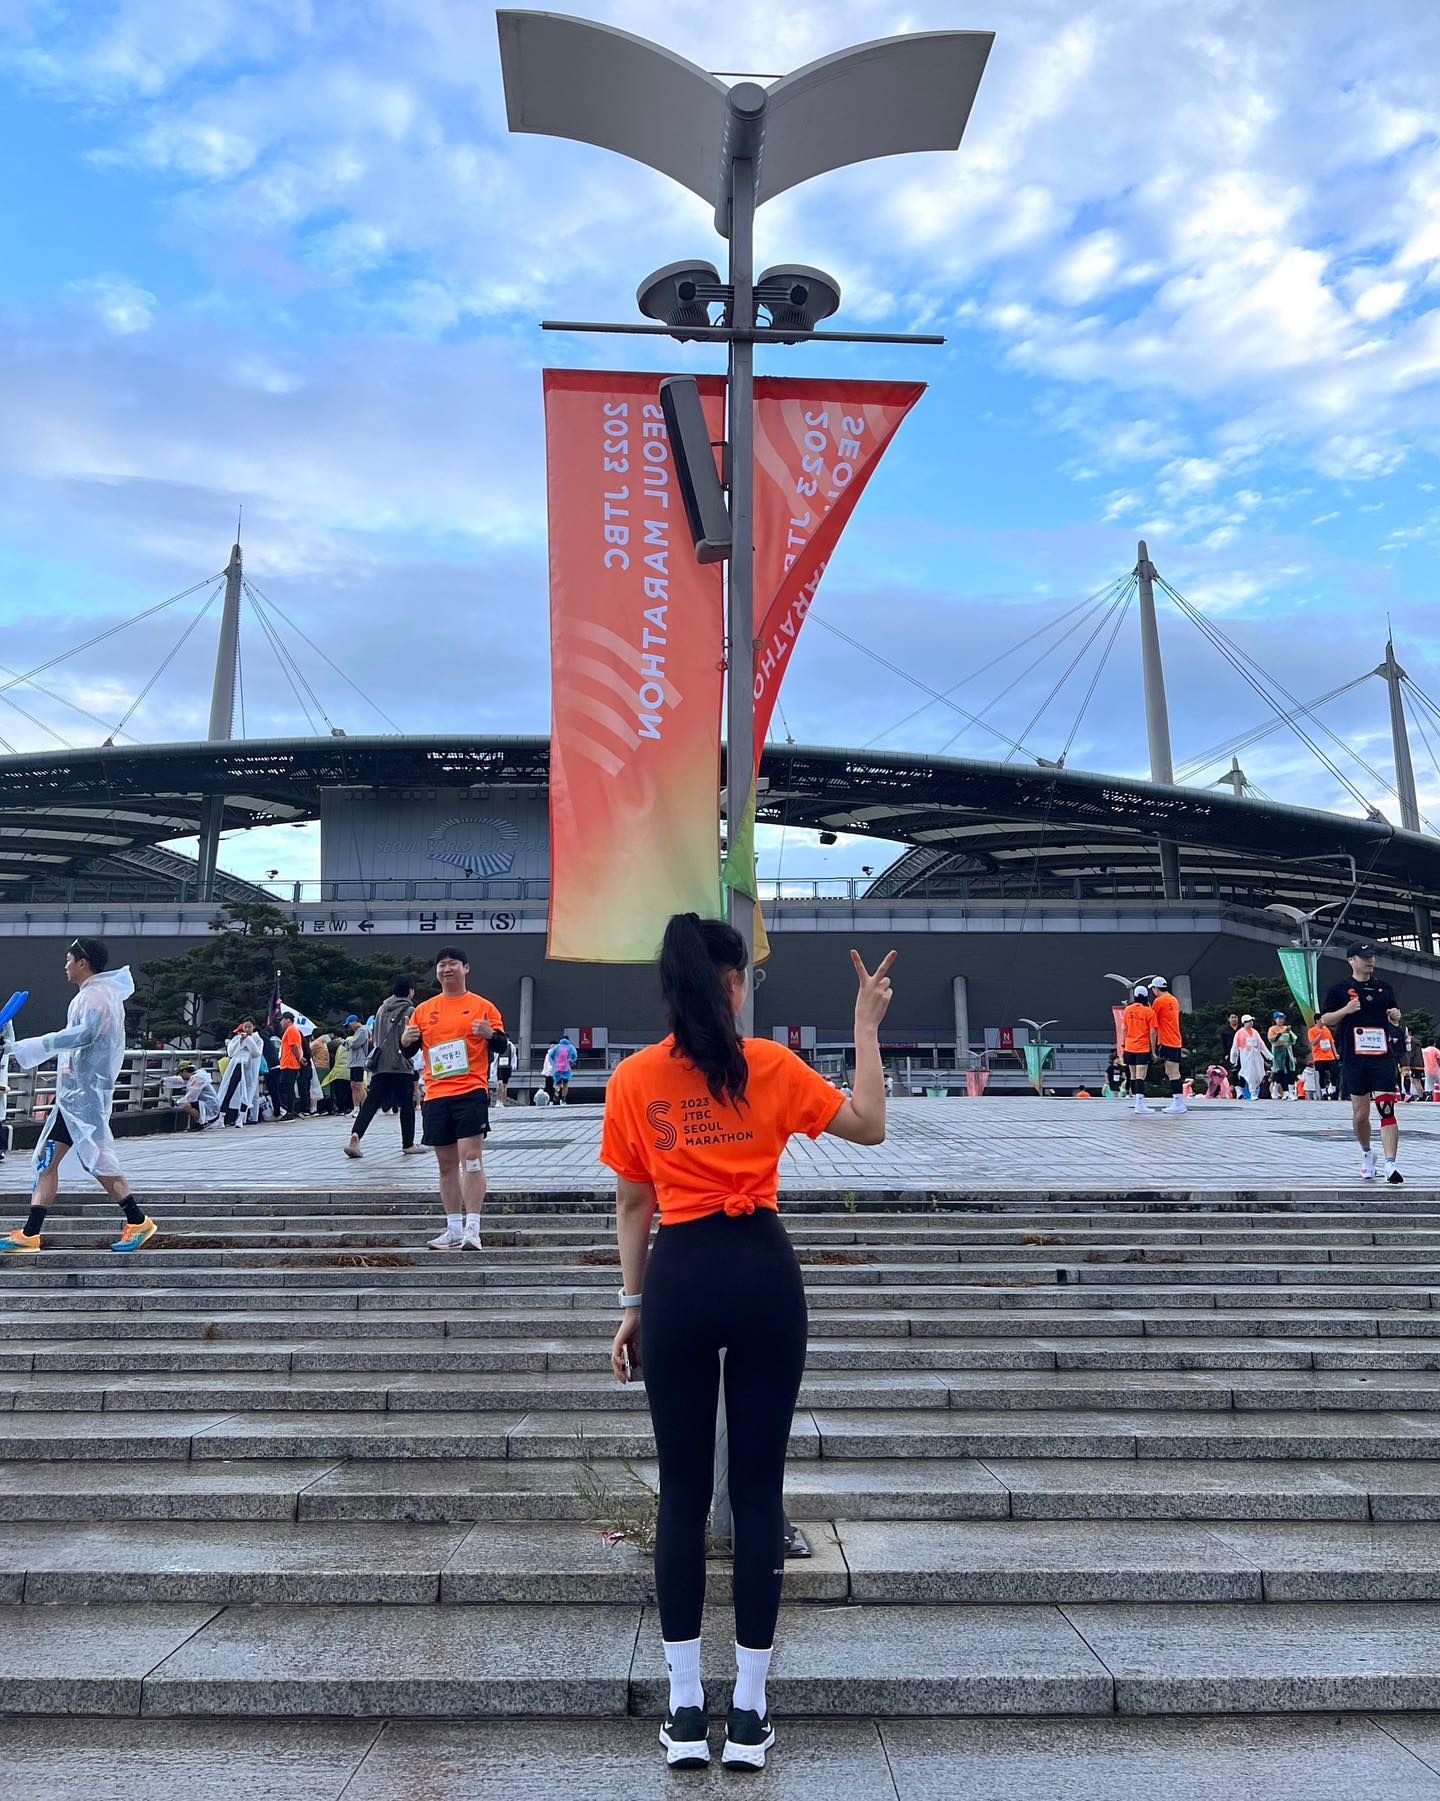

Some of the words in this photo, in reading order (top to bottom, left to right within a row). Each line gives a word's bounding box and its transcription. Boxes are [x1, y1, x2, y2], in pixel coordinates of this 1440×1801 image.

[752, 561, 827, 714] ARATHO
[790, 1031, 799, 1040] M
[681, 1098, 709, 1109] 2023
[682, 1110, 712, 1121] JTBC
[683, 1122, 723, 1134] SEOUL
[685, 1131, 753, 1146] MARATHON
